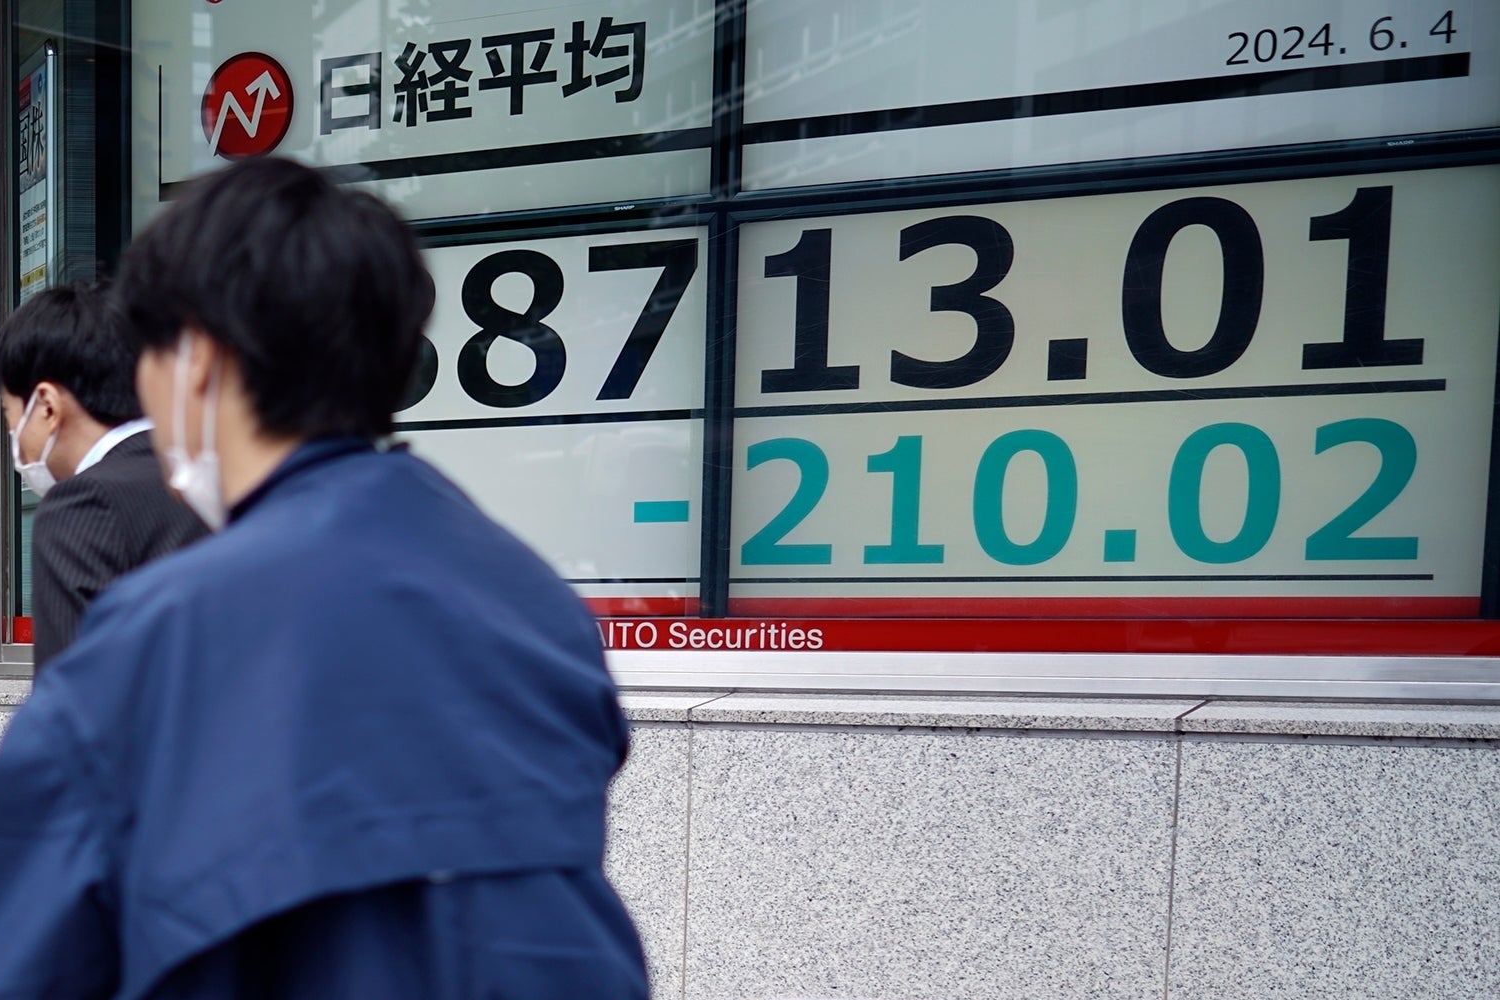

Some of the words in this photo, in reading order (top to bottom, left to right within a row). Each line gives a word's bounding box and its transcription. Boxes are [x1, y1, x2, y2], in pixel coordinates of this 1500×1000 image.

[1226, 23, 1346, 65] 2024.
[1429, 10, 1457, 44] 4
[320, 17, 646, 135] 日経平均
[668, 621, 824, 649] Securities
